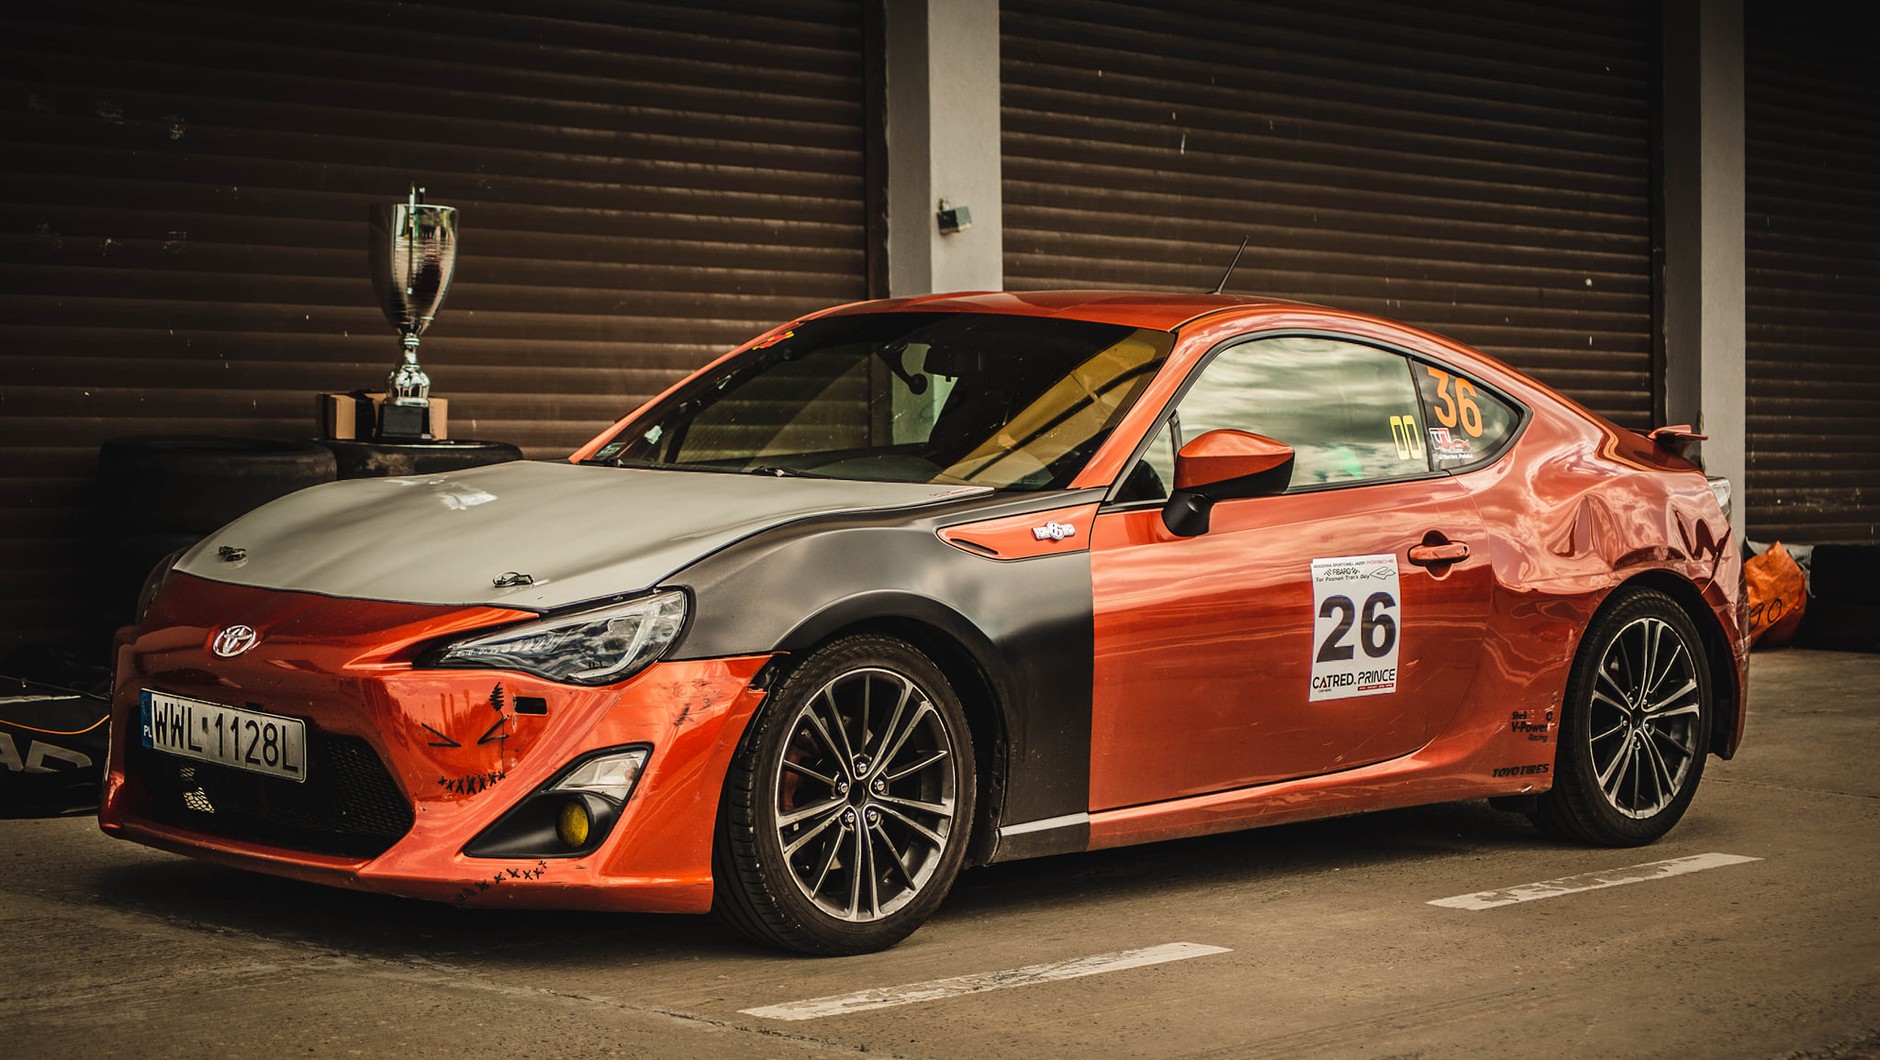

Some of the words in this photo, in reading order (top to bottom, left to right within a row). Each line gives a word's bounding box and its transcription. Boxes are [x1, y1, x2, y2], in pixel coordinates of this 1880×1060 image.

[1427, 366, 1483, 437] 36
[1316, 591, 1397, 663] 26
[143, 725, 152, 738] PL
[153, 700, 202, 753] WWL
[215, 713, 299, 773] 1128L
[1511, 721, 1548, 732] V-Power
